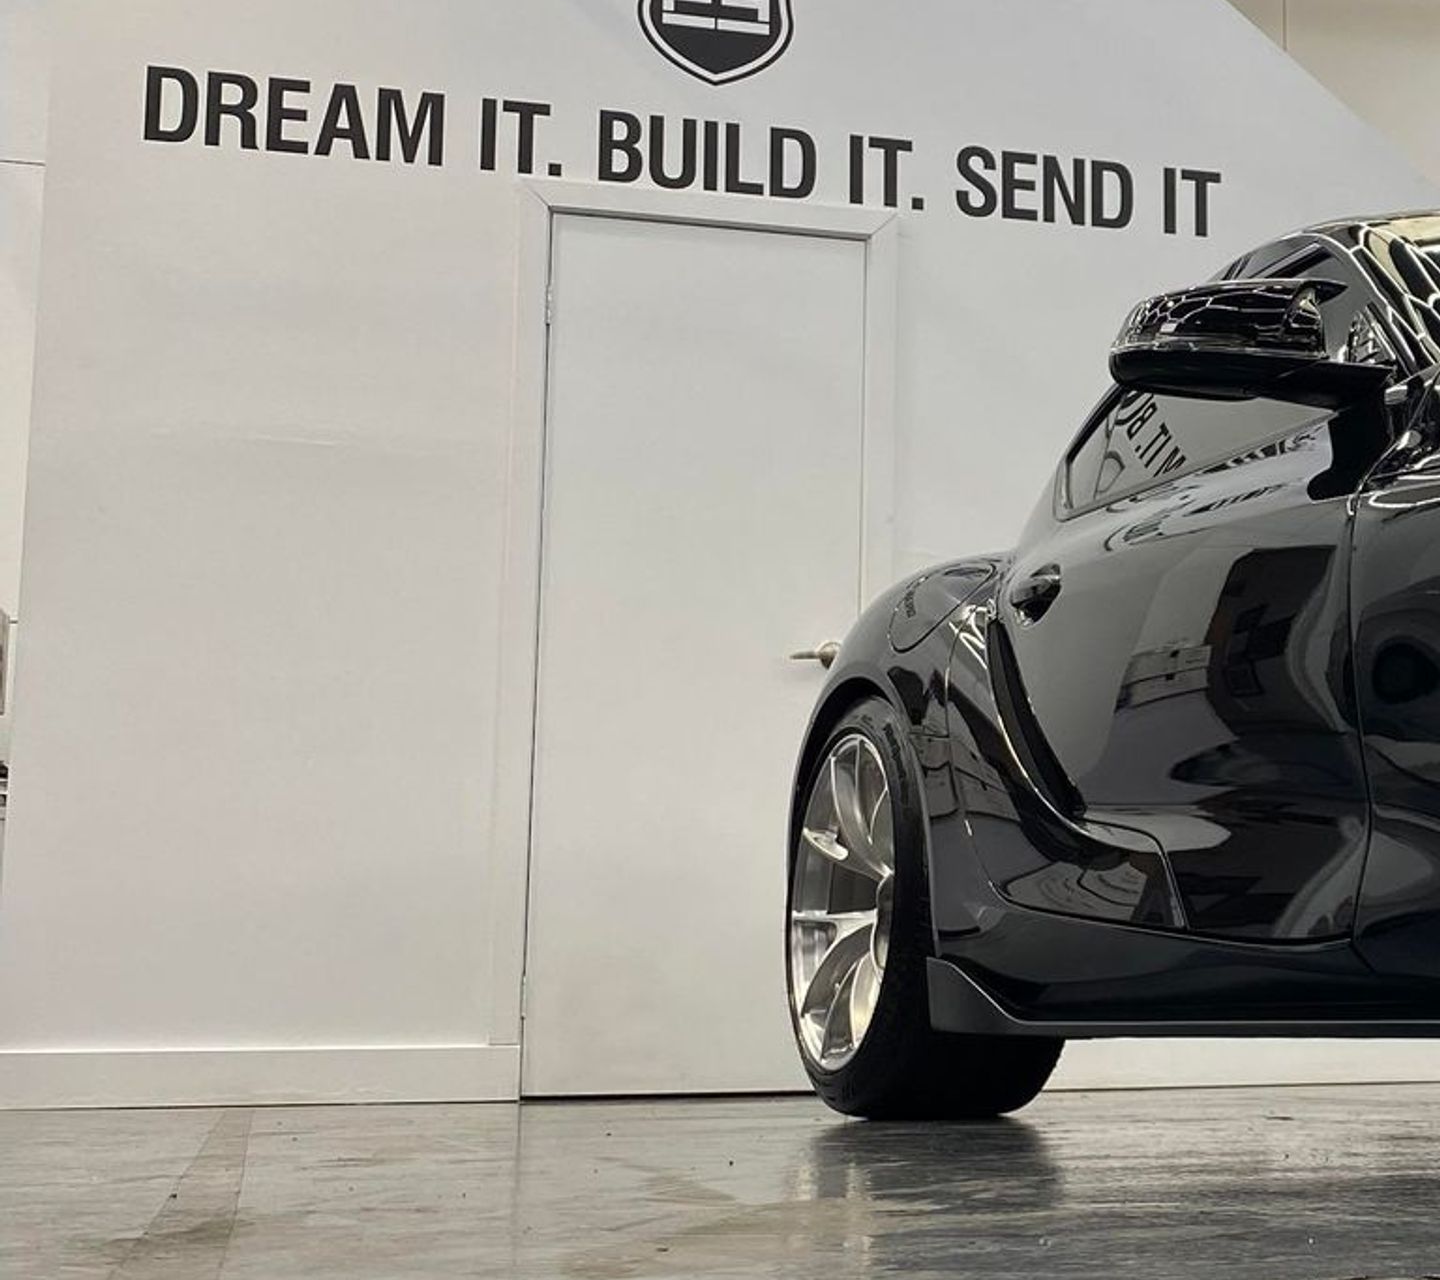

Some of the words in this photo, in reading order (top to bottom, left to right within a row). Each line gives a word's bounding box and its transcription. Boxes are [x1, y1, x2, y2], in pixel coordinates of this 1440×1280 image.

[143, 65, 445, 167] DREAM
[480, 97, 563, 177] IT.
[598, 109, 817, 199] BUILD
[849, 134, 926, 211] IT.
[955, 145, 1134, 229] SEND
[1163, 167, 1222, 238] IT
